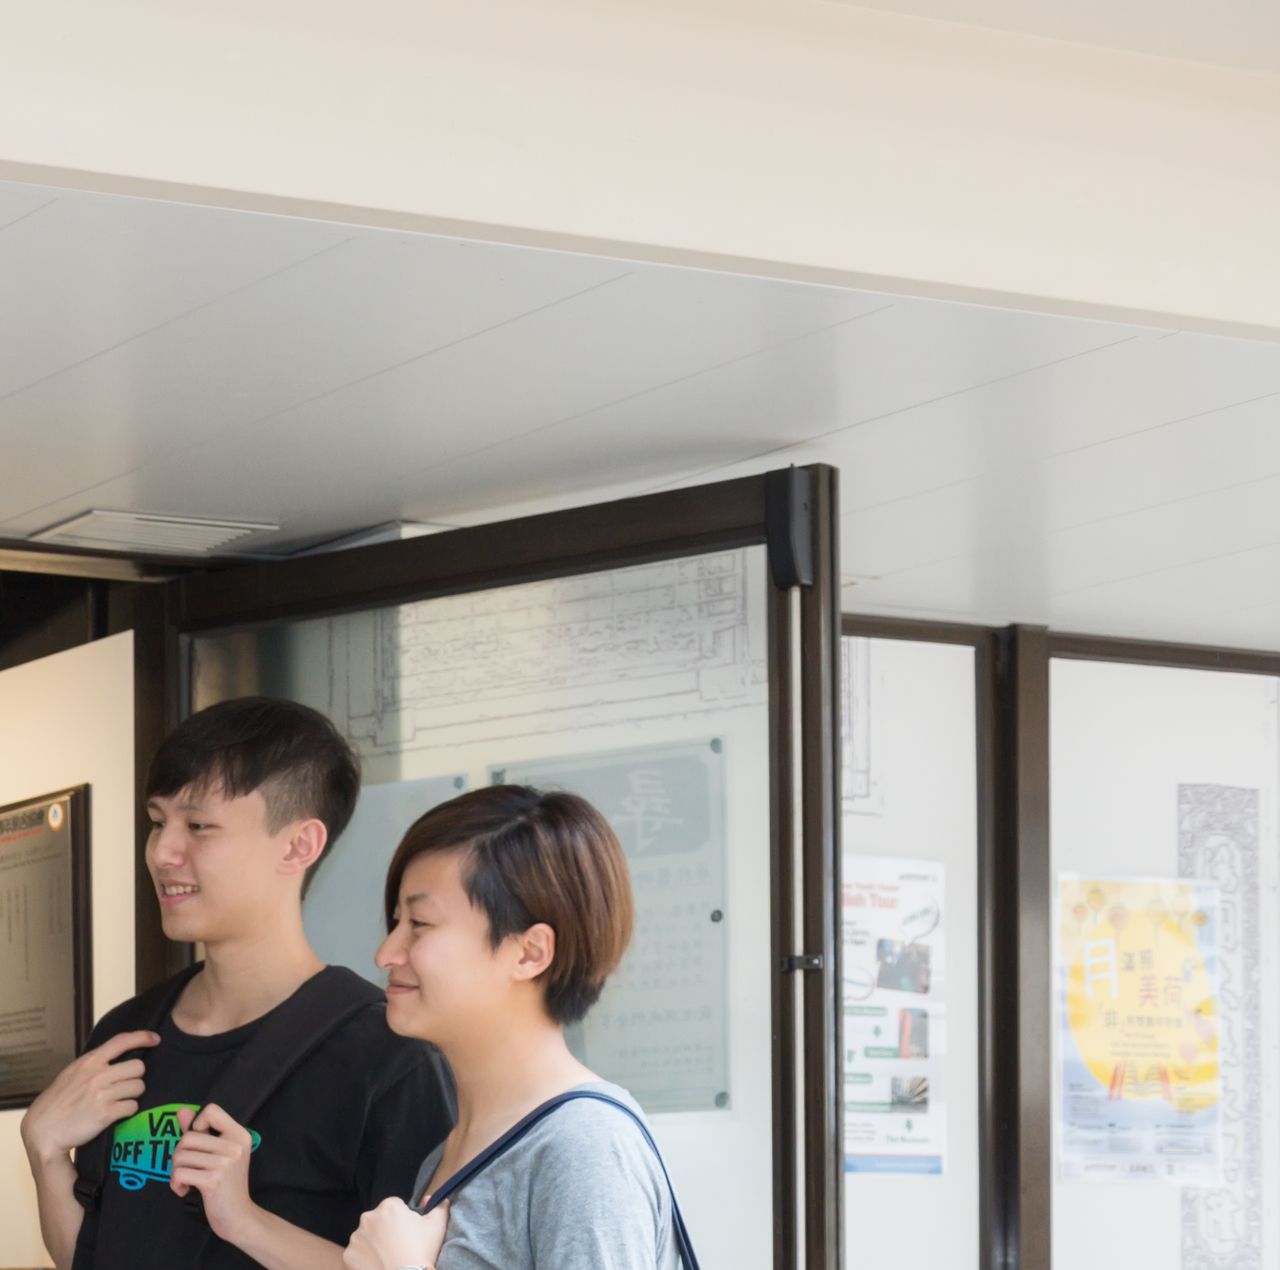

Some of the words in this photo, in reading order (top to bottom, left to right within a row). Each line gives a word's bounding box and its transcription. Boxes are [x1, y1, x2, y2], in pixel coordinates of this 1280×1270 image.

[148, 1111, 183, 1137] VA
[113, 1140, 145, 1164] OFF
[149, 1140, 179, 1171] TH
